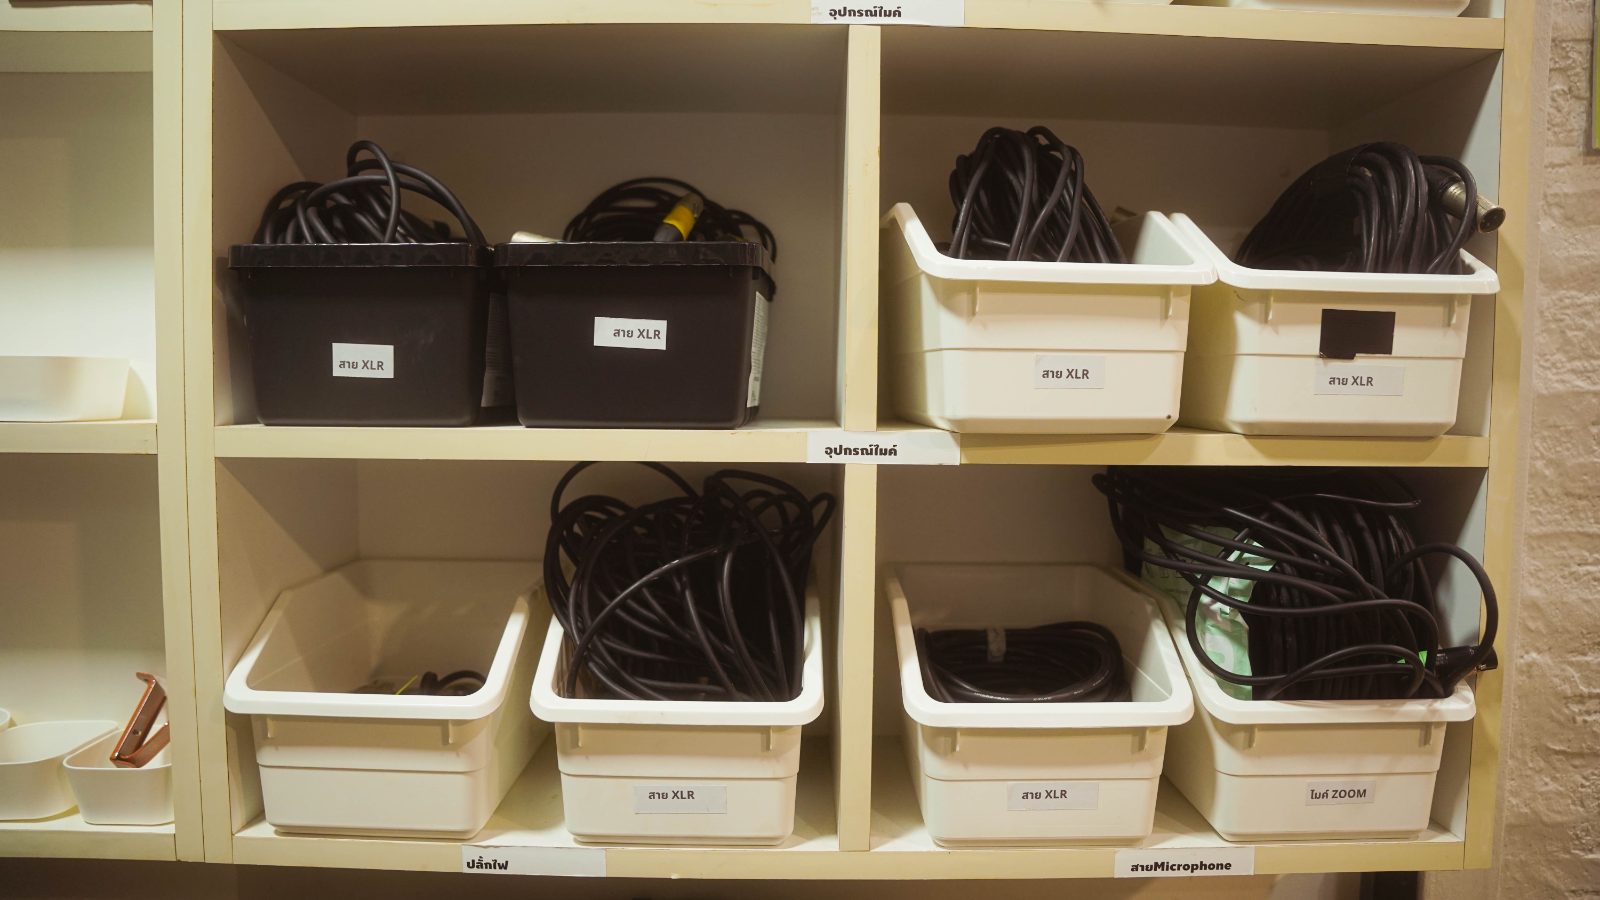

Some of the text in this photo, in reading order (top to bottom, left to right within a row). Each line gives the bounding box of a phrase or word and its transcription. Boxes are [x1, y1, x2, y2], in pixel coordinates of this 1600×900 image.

[828, 5, 902, 20] อุปกรณ์ไมค์
[613, 328, 662, 341] สาย XLR
[338, 359, 385, 371] สาย XLR
[1041, 368, 1090, 380] สาย XLR
[1328, 375, 1374, 387] สาย XLR
[824, 443, 898, 459] อุปกรณ์ไมค์
[648, 790, 695, 800] สาย XLR
[1021, 789, 1068, 800] สาย XLR
[1310, 788, 1367, 800] ไมค์ ZOOM
